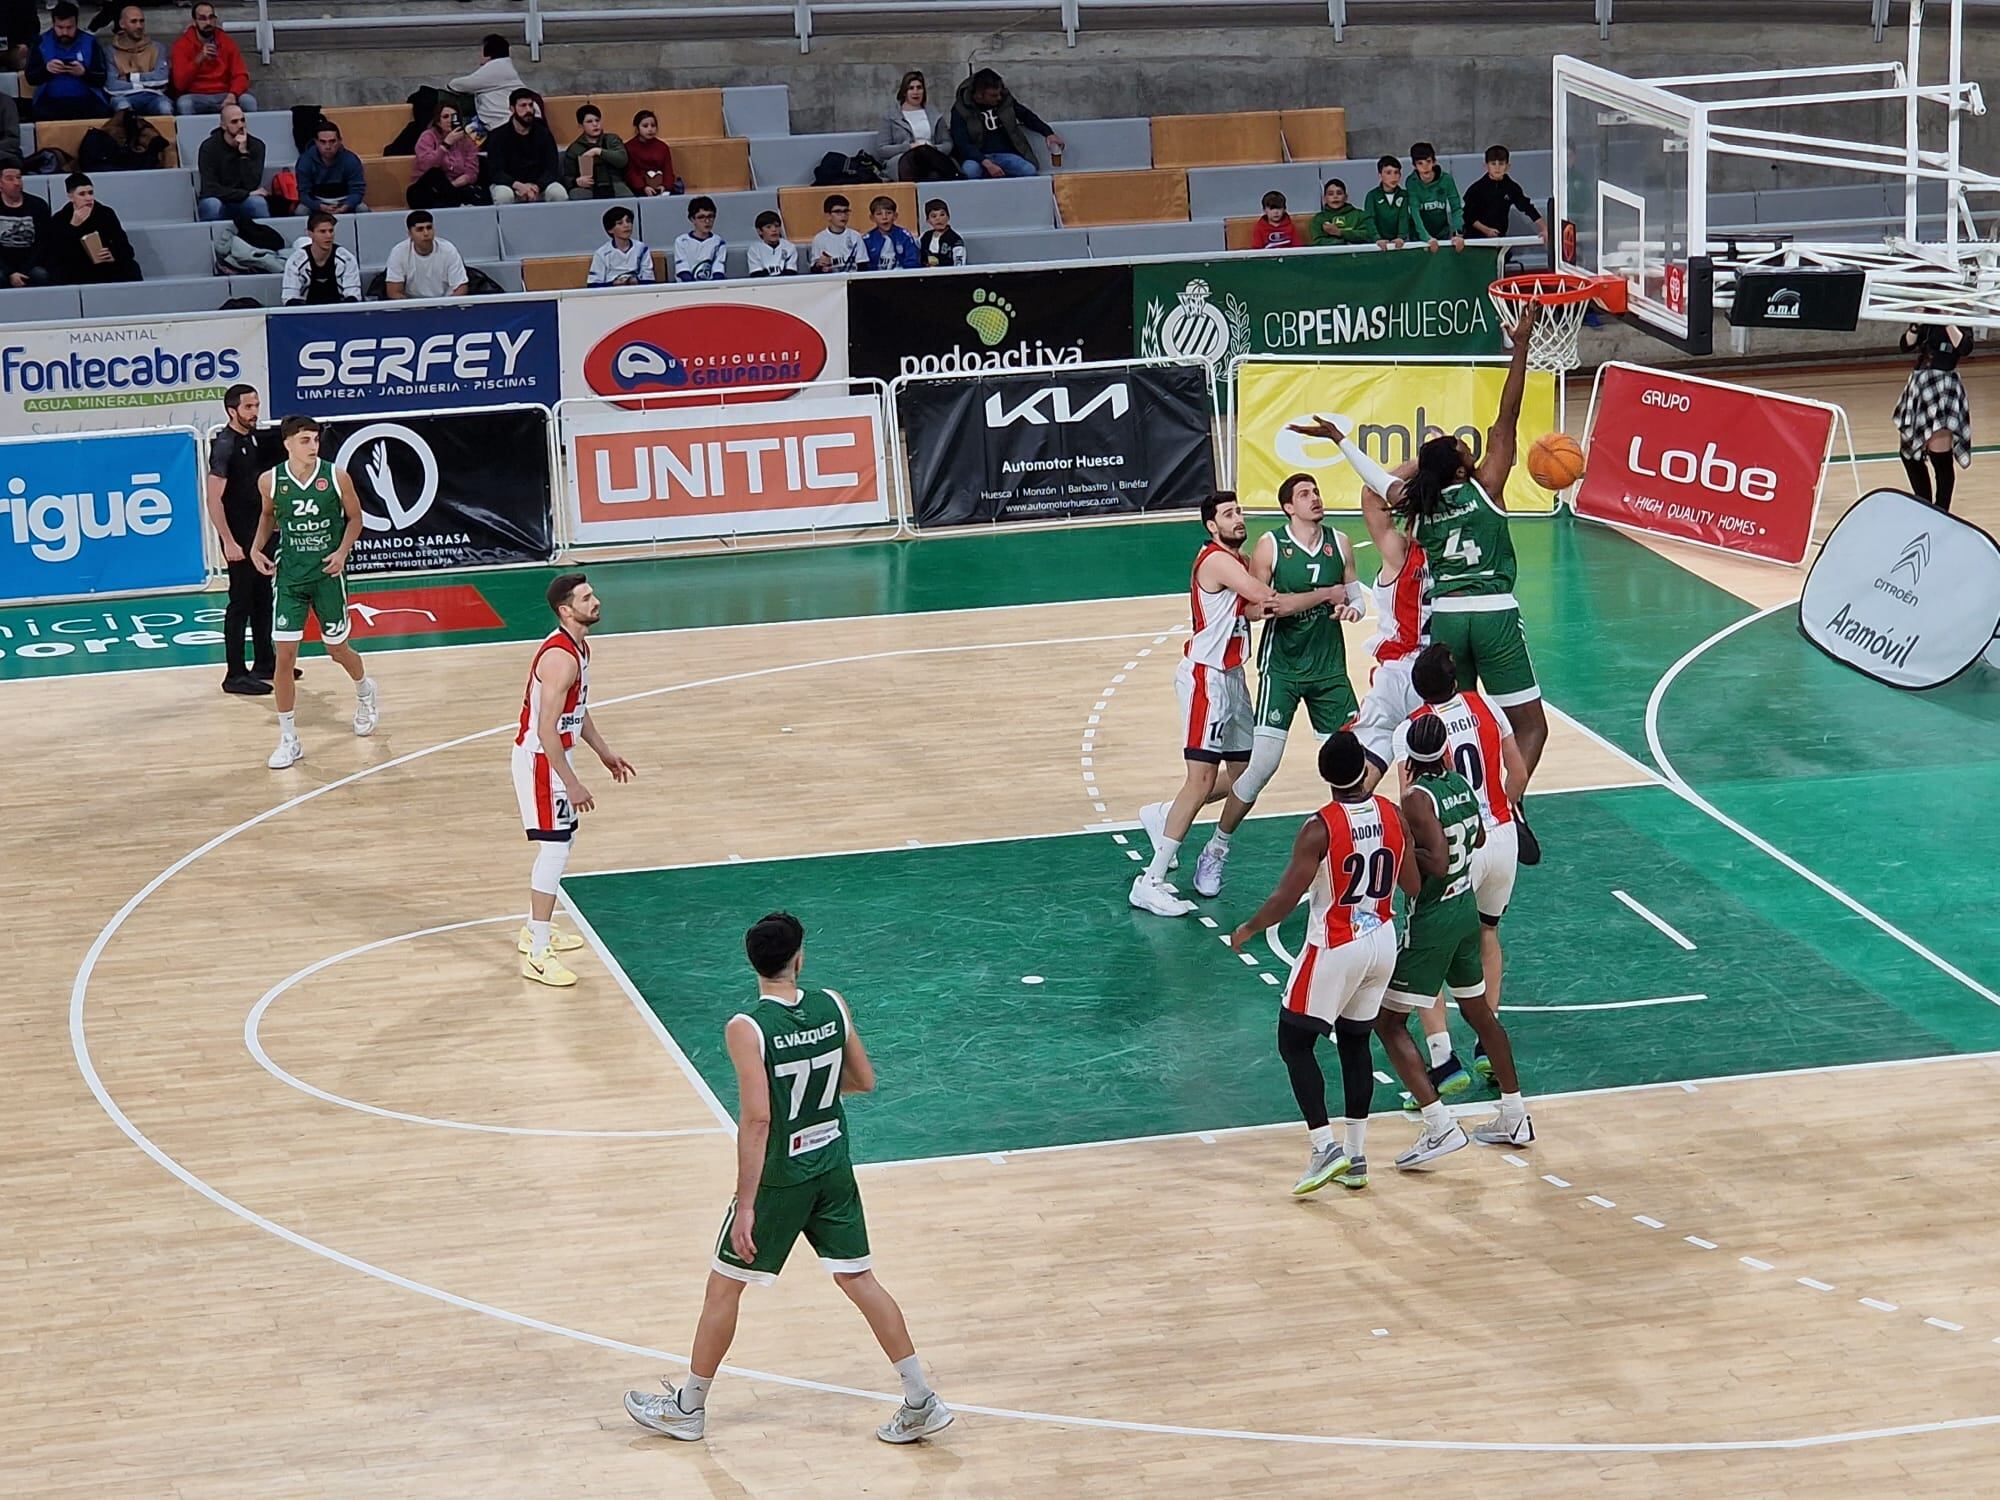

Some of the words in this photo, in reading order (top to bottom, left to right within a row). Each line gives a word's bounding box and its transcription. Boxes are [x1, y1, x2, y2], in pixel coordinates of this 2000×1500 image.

[70, 329, 158, 344] MANANTIAL
[297, 329, 535, 387] SERFEY
[900, 340, 1082, 378] podoactiva
[27, 399, 72, 412] AGUA
[78, 395, 147, 409] MINERAL
[153, 388, 225, 404] NATURAL
[297, 388, 365, 400] LIMPIEZA
[379, 382, 460, 396] JARDINERIA
[474, 376, 536, 390] PISCINAS
[985, 383, 1129, 428] KIA
[1641, 389, 1690, 412] GRUPO
[595, 433, 859, 503] UNITIC
[1002, 457, 1073, 474] Automotor
[1076, 455, 1124, 469] Huesca
[1628, 436, 1777, 501] Lobe
[981, 490, 1012, 500] Huesca
[1023, 486, 1056, 497] Monzón
[1068, 482, 1108, 494] Barbastro
[1119, 479, 1149, 490] Binéfar
[292, 498, 319, 516] 24
[1006, 497, 1119, 512] www.automotorhuesca.com
[1635, 495, 1664, 513] HIGH
[1667, 503, 1714, 525] QUALITY
[1717, 514, 1756, 536] HOMES
[350, 537, 413, 551] RNANDO
[415, 533, 471, 547] SARASA
[1443, 528, 1482, 565] 4
[357, 554, 369, 562] DE
[371, 551, 413, 561] MEDICINA
[416, 547, 463, 558] DEPORTIVA
[395, 558, 453, 568] FISIOTERAPIA
[1306, 564, 1320, 583] 7
[325, 620, 345, 635] 24
[1826, 603, 1920, 668] Aramóvil
[1339, 847, 1395, 906] 20
[774, 1047, 842, 1121] 77
